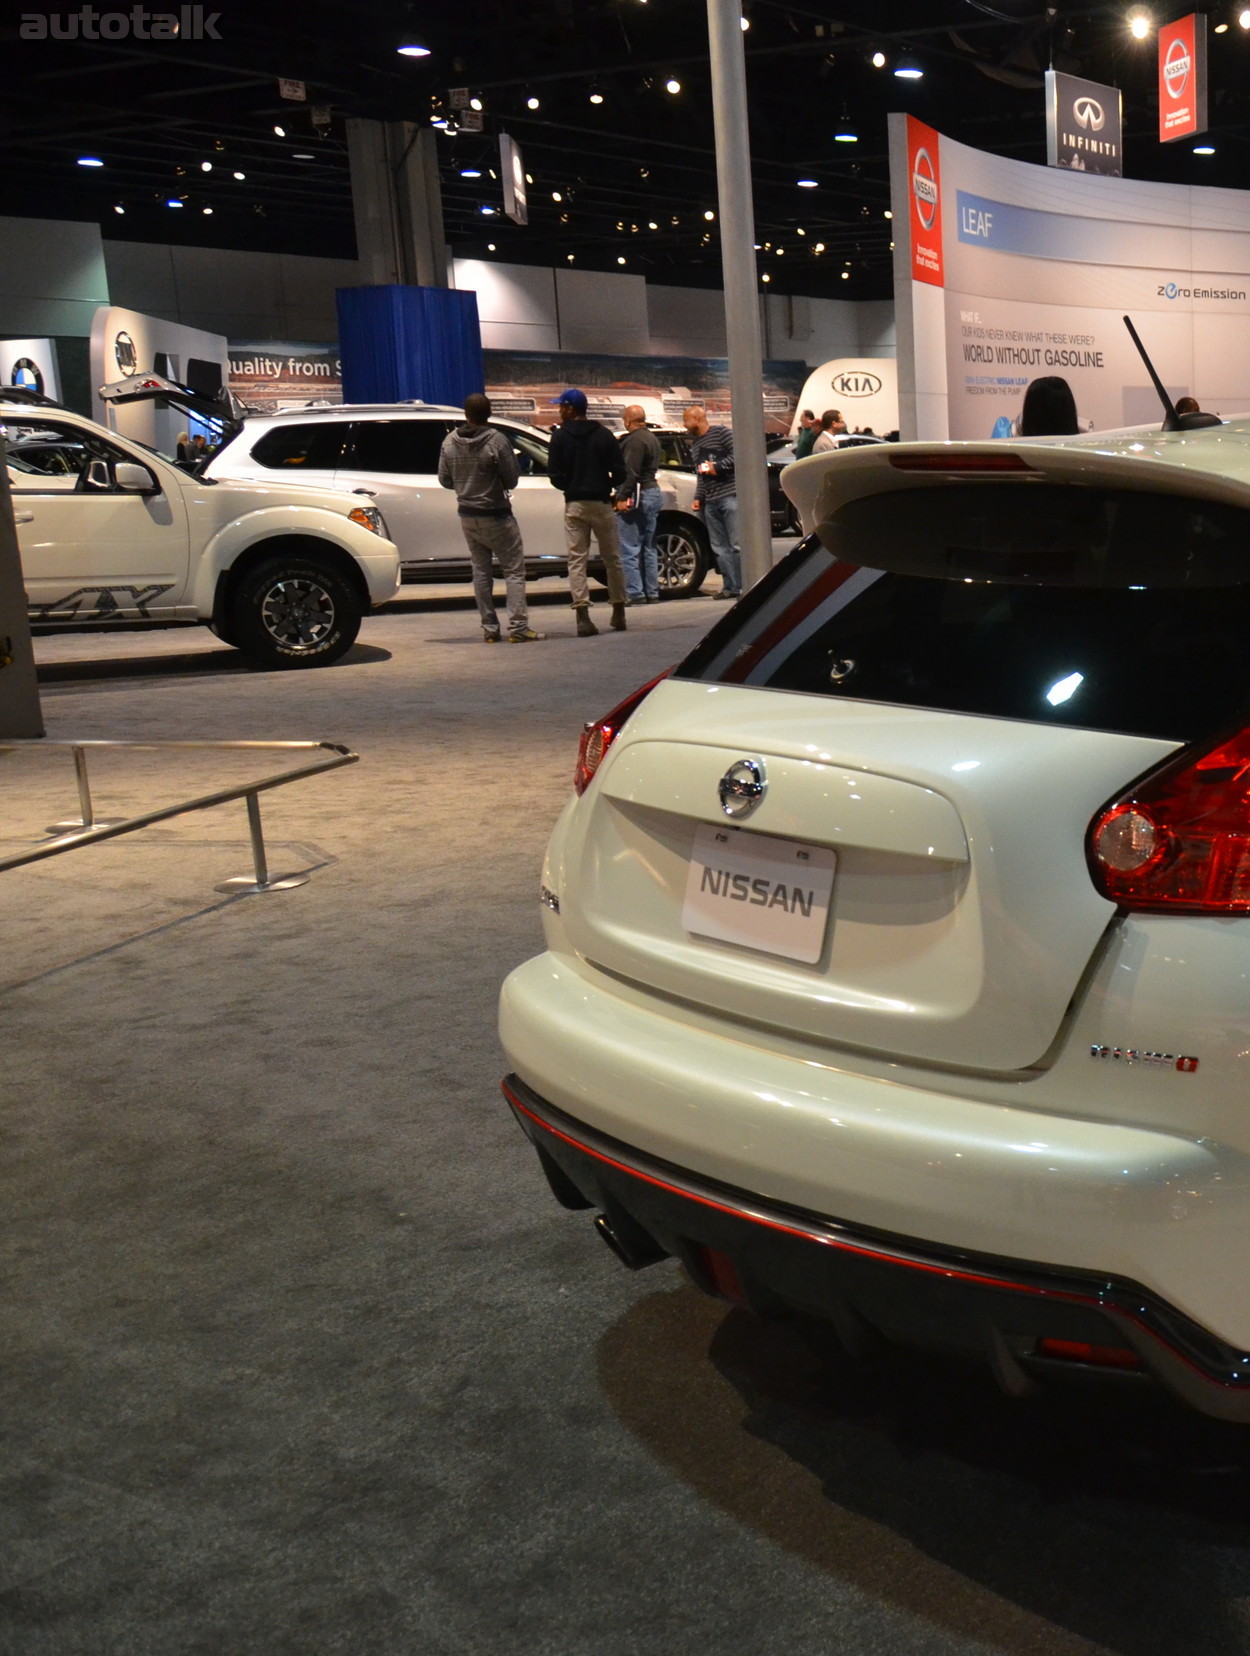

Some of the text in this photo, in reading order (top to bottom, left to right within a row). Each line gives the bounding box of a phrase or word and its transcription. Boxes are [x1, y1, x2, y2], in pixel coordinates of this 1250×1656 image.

[1166, 60, 1188, 75] NISSAN
[1063, 132, 1116, 157] INFINITI
[915, 178, 936, 199] NISSAN
[962, 206, 994, 237] LEAF
[1193, 288, 1246, 300] Emission
[986, 328, 1004, 340] NEVER
[1005, 330, 1024, 341] KNEW
[1024, 331, 1044, 343] WHAT
[1045, 332, 1067, 344] THESE
[1068, 334, 1095, 346] WERE?
[963, 343, 1104, 368] WORLD WITHOUT GASOLINE
[287, 357, 330, 377] from
[840, 377, 873, 392] KIA
[700, 866, 814, 918] NISSAN
